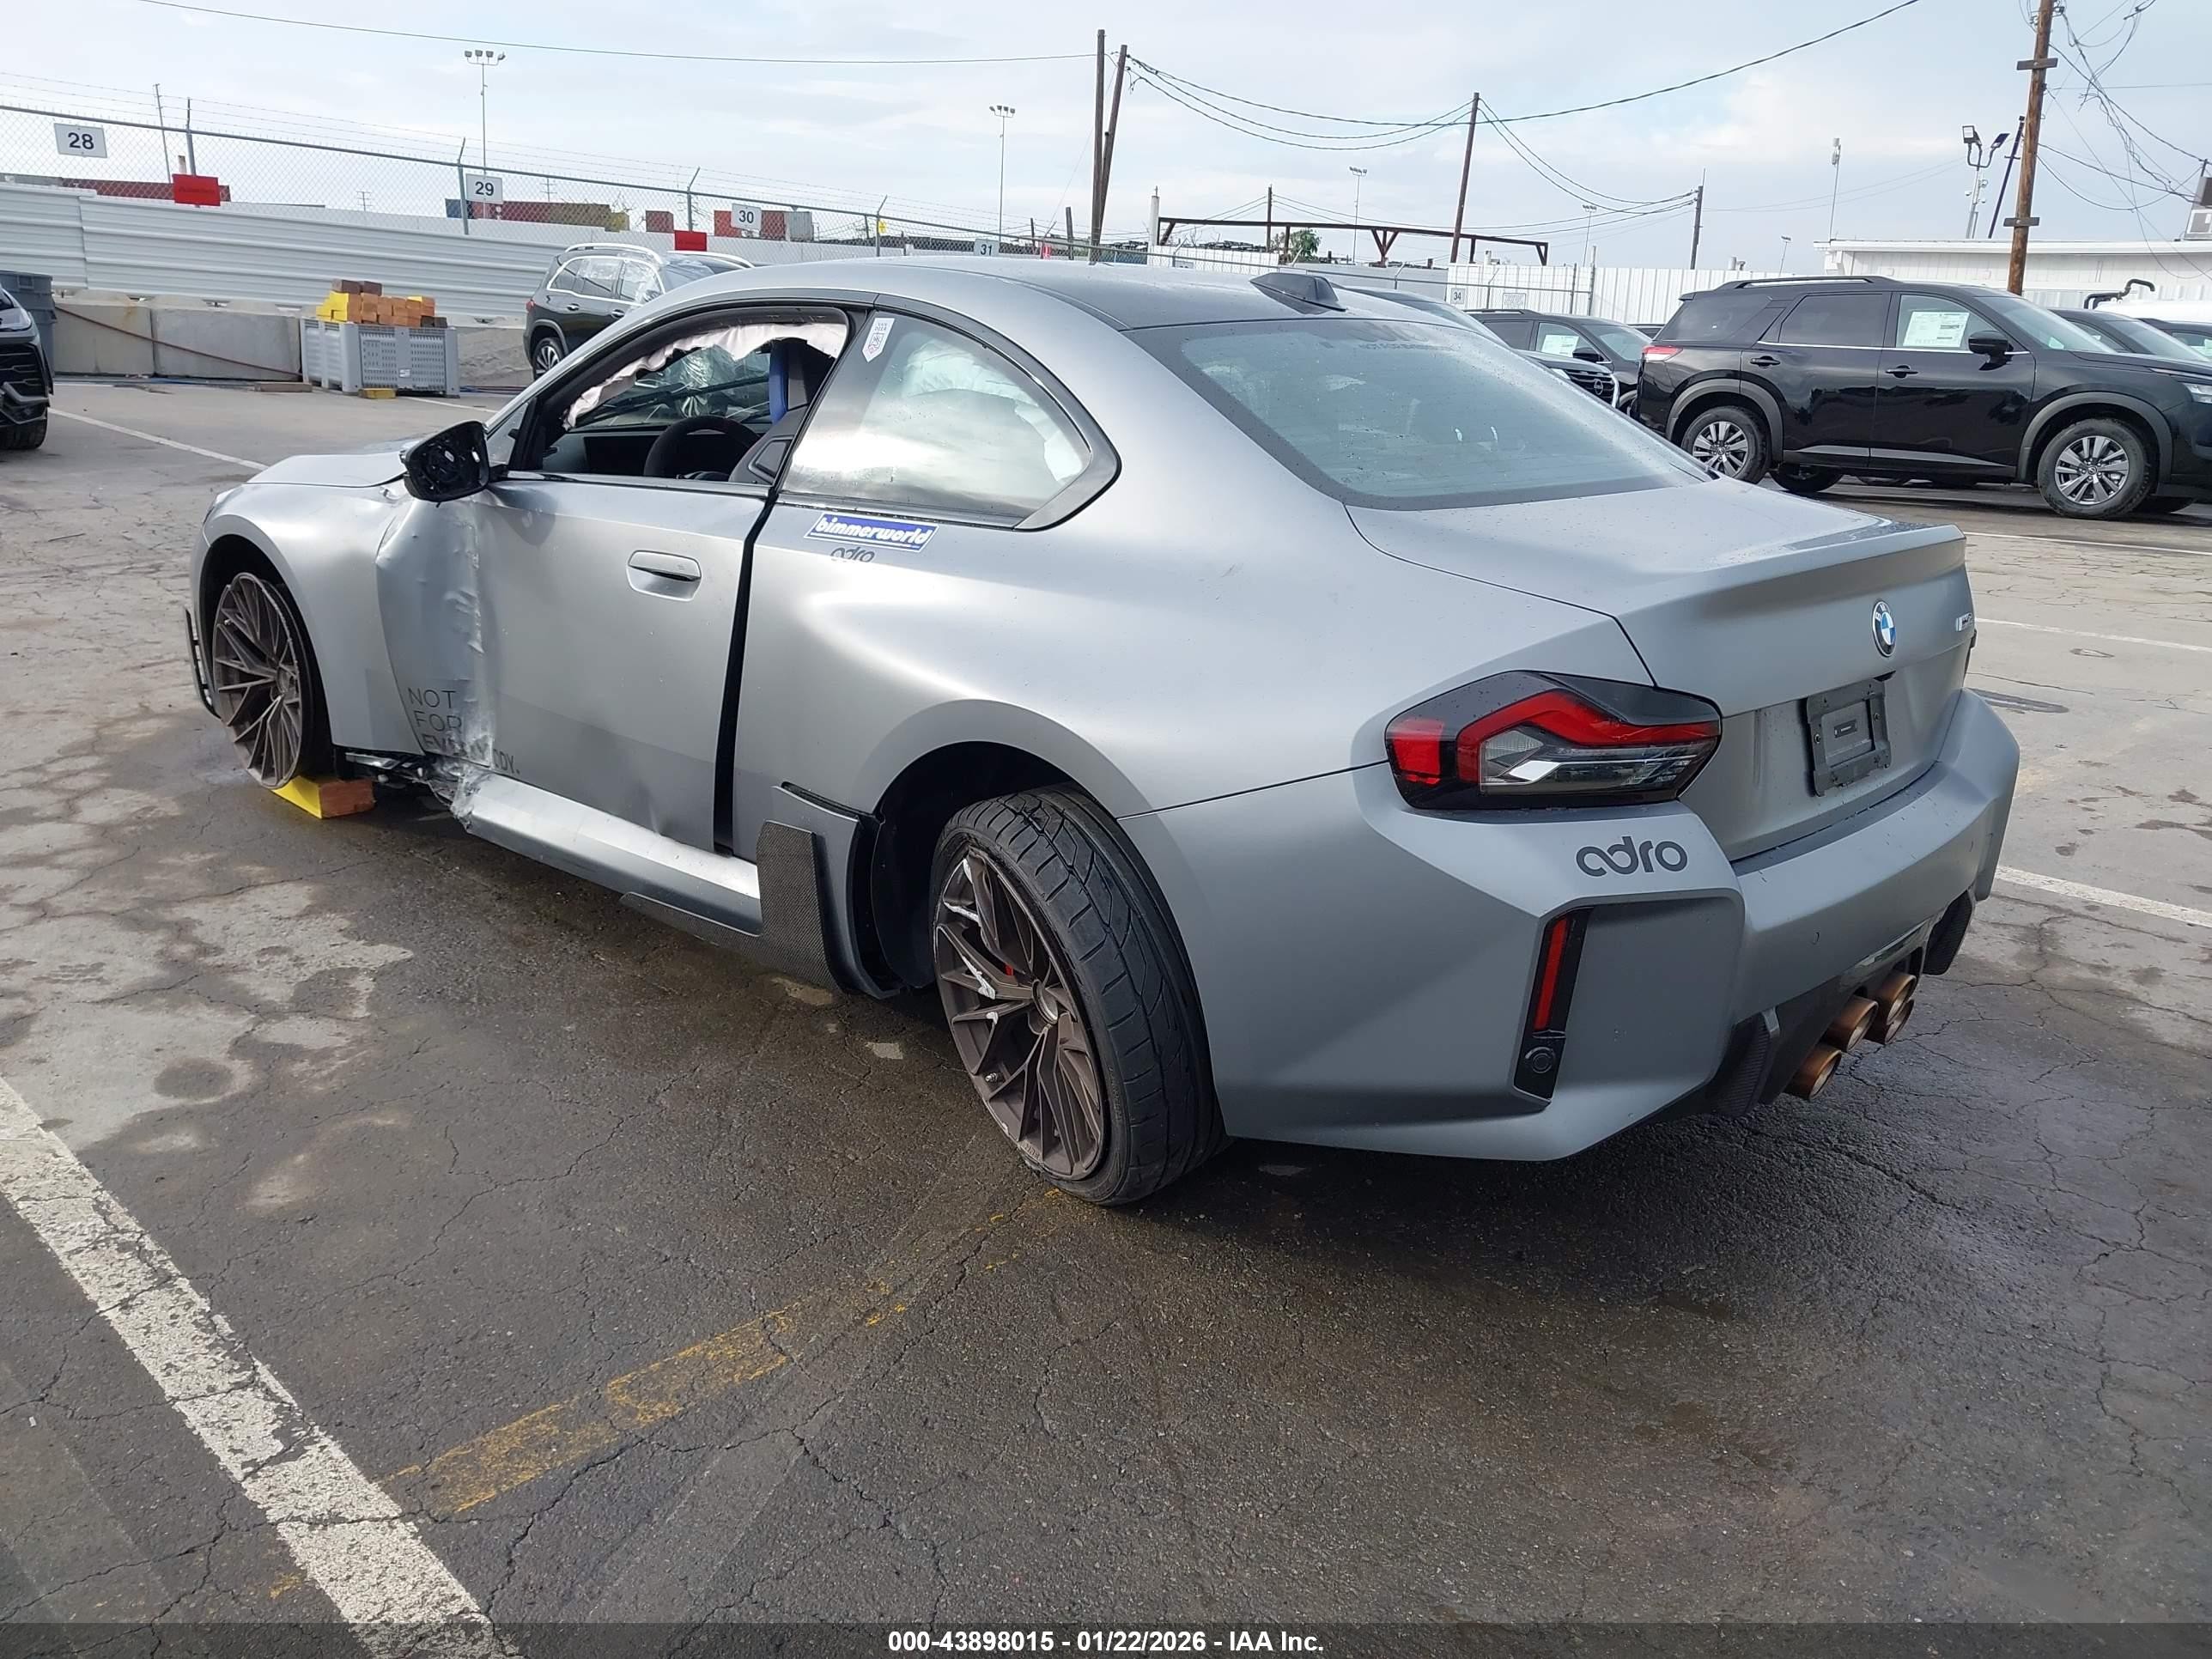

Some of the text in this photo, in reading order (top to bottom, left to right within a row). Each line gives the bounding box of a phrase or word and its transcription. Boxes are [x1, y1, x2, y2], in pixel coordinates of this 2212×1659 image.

[68, 132, 94, 149] 28
[475, 181, 494, 196] 29
[738, 210, 754, 223] 30
[980, 244, 993, 256] 31
[1454, 292, 1462, 301] 34
[815, 517, 933, 544] bimmerworld
[408, 688, 456, 708] NOT
[414, 710, 463, 733] FOR
[1576, 836, 1688, 877] adro
